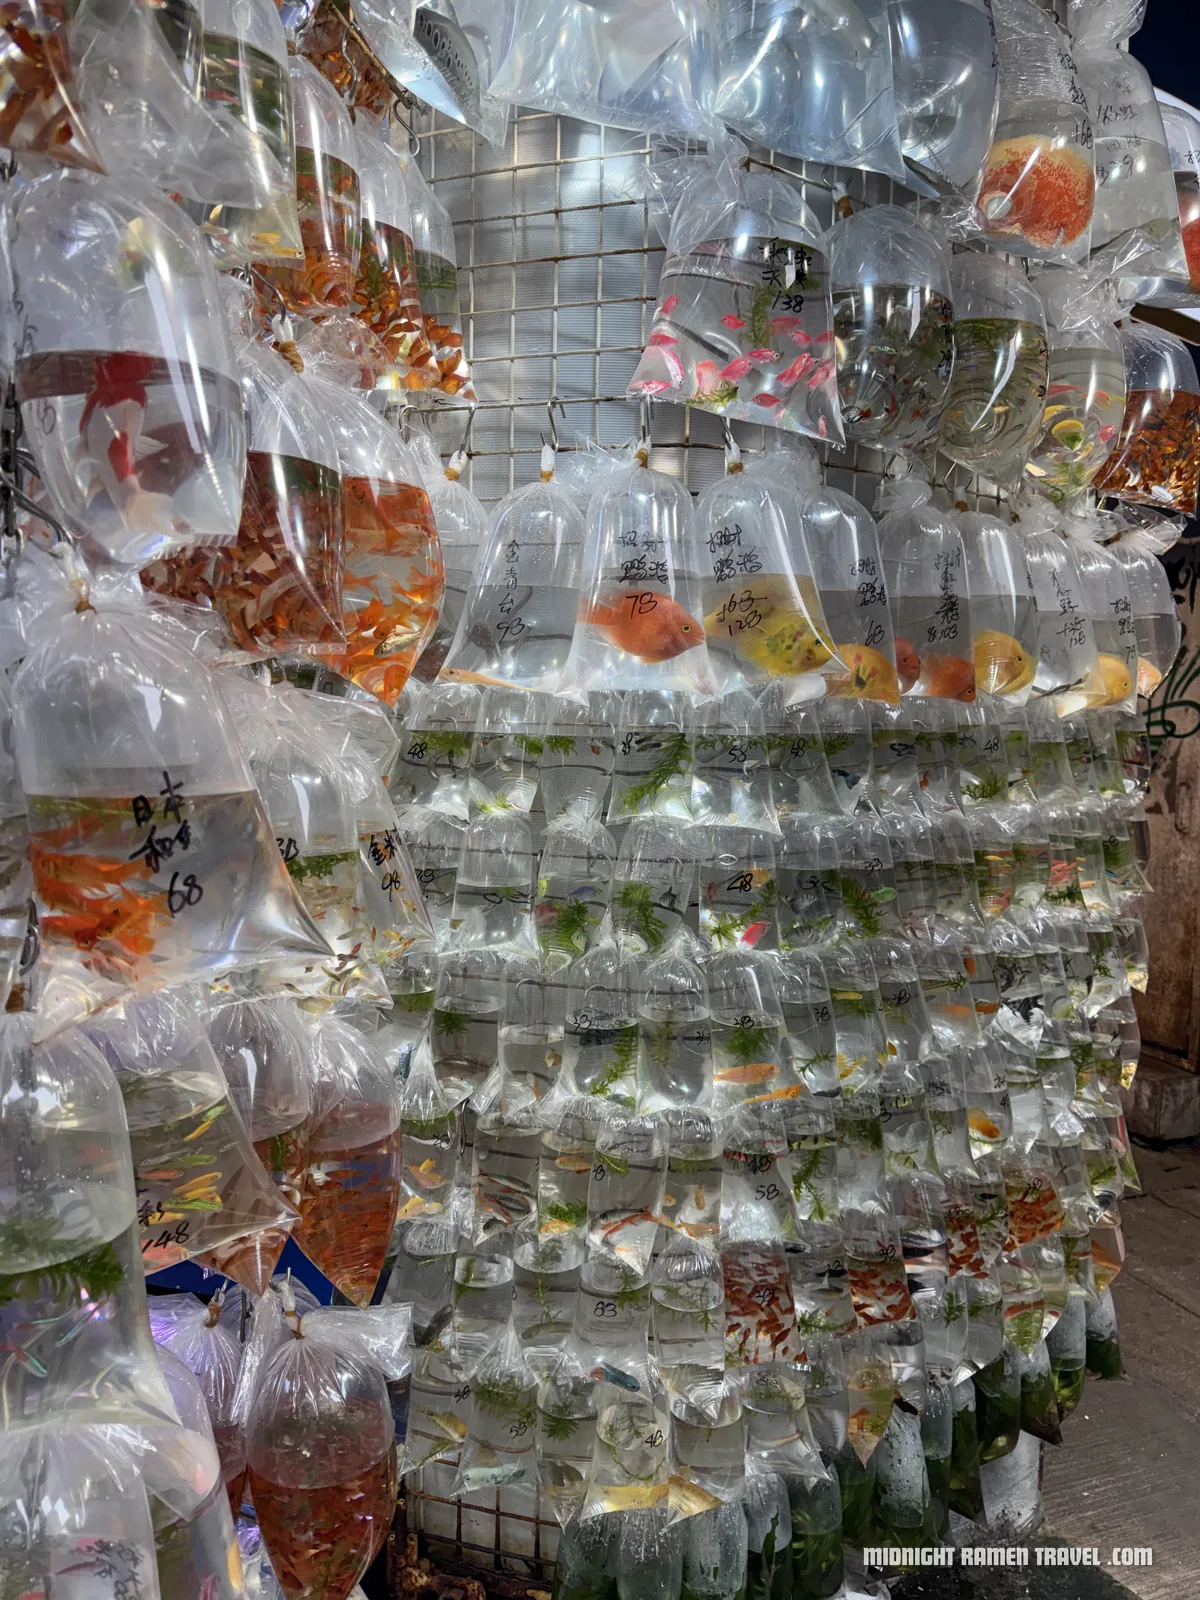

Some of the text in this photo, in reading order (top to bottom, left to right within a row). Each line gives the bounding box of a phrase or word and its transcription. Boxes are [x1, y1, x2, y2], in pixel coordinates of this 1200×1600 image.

[771, 290, 804, 313] 138
[625, 591, 657, 620] 78
[496, 617, 525, 645] 98
[865, 620, 885, 646] 68
[407, 742, 428, 760] 48
[728, 743, 750, 763] 58
[984, 737, 999, 752] 48
[132, 771, 184, 826] 日本
[726, 872, 754, 893] 48
[167, 871, 204, 918] 68
[573, 1014, 593, 1032] 38
[814, 1006, 831, 1022] 38
[755, 1183, 780, 1201] 58
[454, 1385, 471, 1403] 38
[509, 1421, 528, 1439] 58
[645, 1430, 664, 1448] 48
